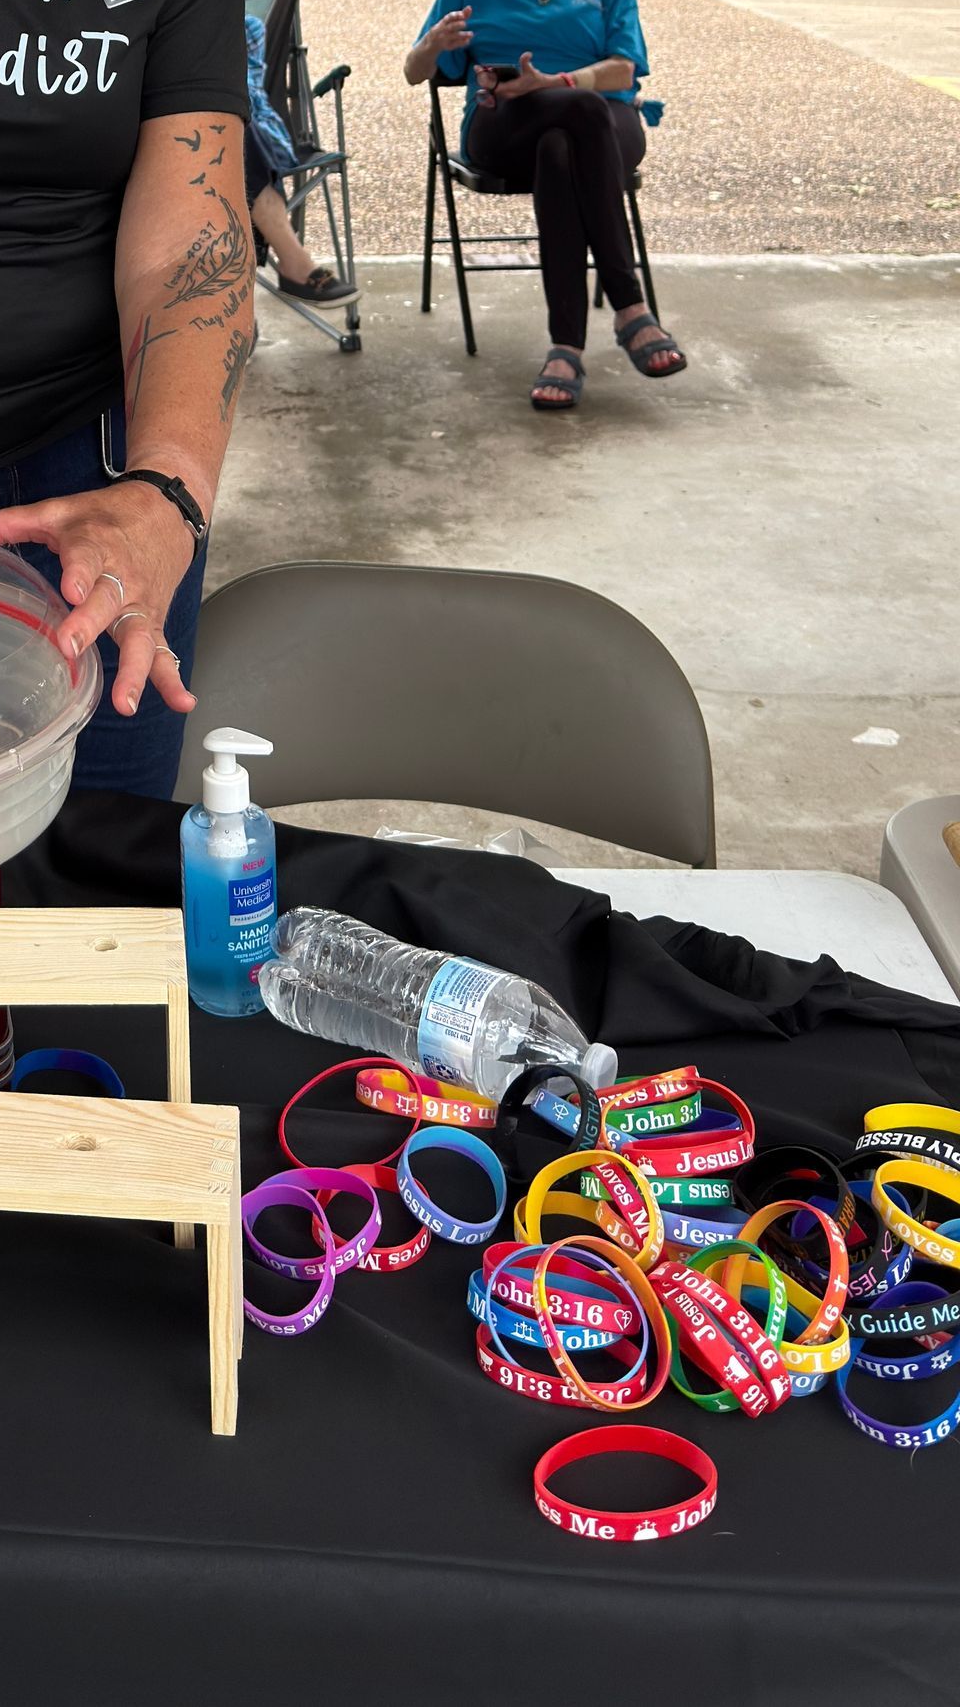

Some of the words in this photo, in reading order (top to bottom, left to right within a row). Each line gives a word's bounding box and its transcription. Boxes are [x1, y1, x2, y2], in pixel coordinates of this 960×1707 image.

[242, 857, 266, 871] NEW
[233, 877, 273, 897] University
[237, 890, 271, 908] Medical
[228, 934, 270, 952] SANITIZ
[240, 924, 269, 940] HAND
[425, 1100, 471, 1123] 3:16
[597, 1089, 649, 1108] oves
[620, 1109, 676, 1133] John
[679, 1101, 702, 1124] 3:1
[855, 1132, 927, 1151] BLESSED
[676, 1149, 739, 1173] Jesus
[596, 1161, 634, 1206] Loves
[397, 1175, 443, 1233] Jesus
[388, 1227, 431, 1266] oves
[673, 1219, 734, 1248] Jesu
[244, 1311, 297, 1335] oves
[301, 1293, 330, 1330] Me
[548, 1294, 604, 1326] 3:16
[671, 1267, 728, 1313] John
[728, 1310, 779, 1370] 3:16
[674, 1291, 717, 1342] Jesus
[770, 1267, 787, 1342] John
[859, 1311, 926, 1334] Guide
[499, 1366, 553, 1401] 3:16
[894, 1419, 952, 1447] 3:16
[568, 1511, 616, 1540] Me
